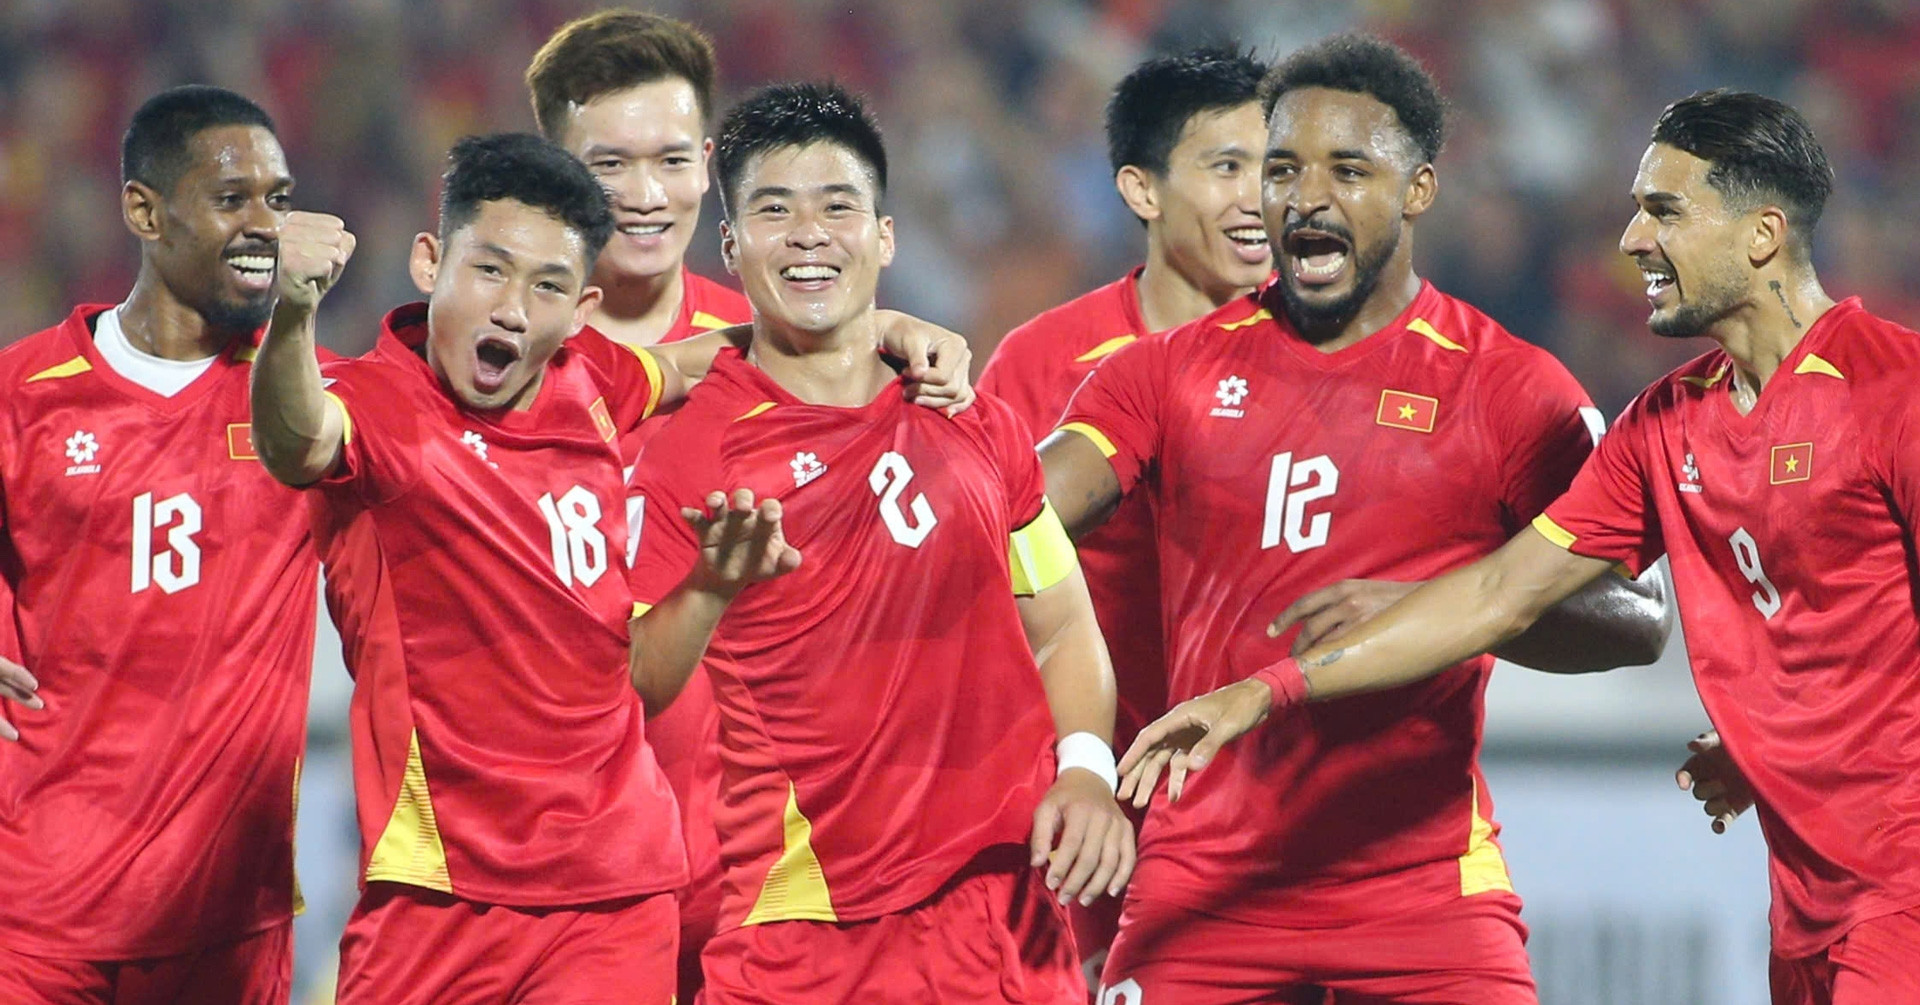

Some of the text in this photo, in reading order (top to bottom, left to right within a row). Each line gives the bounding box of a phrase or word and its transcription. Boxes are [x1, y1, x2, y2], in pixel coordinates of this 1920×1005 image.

[131, 491, 202, 595] 13
[537, 484, 608, 588] 18
[868, 451, 938, 549] 2
[1261, 451, 1340, 553] 12
[1728, 526, 1781, 621] 9
